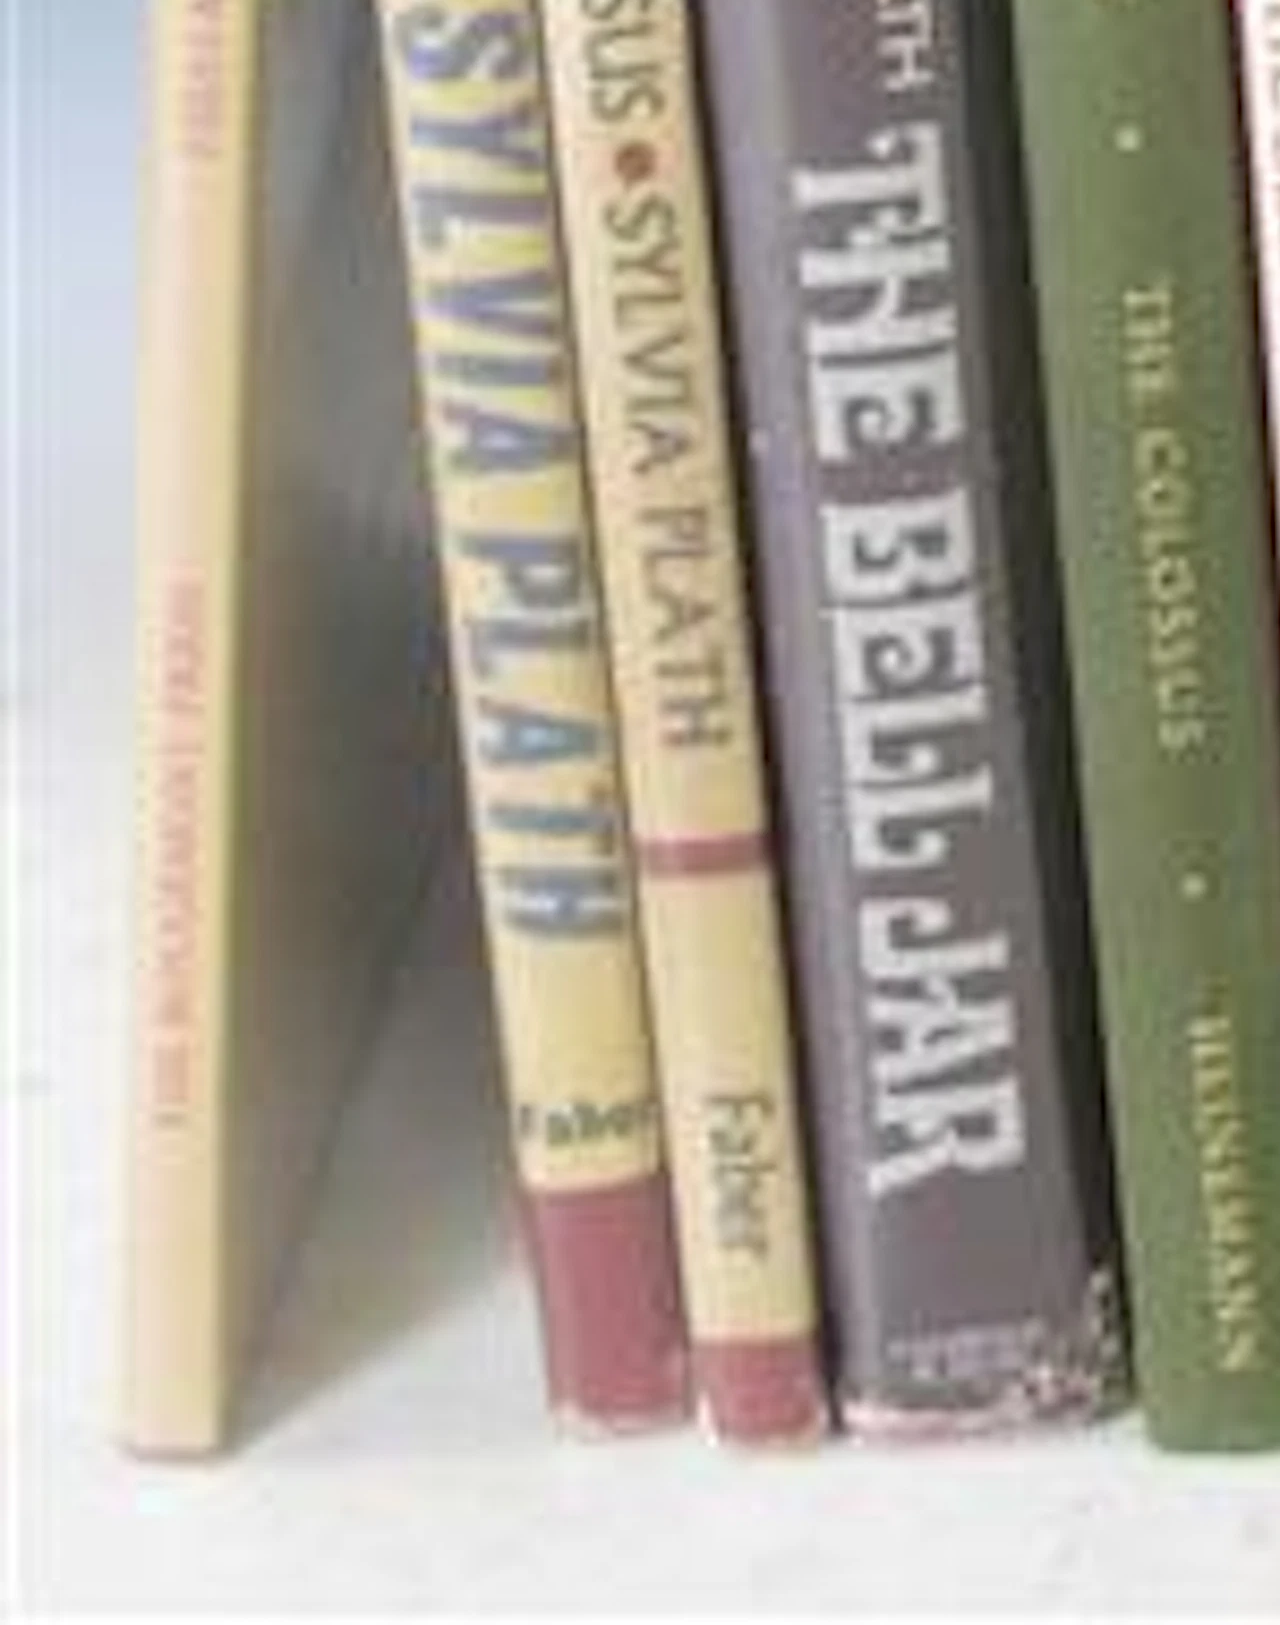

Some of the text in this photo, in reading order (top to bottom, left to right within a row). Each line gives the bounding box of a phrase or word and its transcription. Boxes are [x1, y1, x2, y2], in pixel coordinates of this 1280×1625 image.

[400, 4, 592, 482] SYLVIA
[603, 192, 698, 479] SYLVIA
[793, 124, 972, 461] THE
[640, 502, 738, 752] PLATH
[818, 487, 1000, 874] BELL
[1121, 277, 1208, 759] THE COLOSSUS
[455, 524, 640, 944] PLATH
[703, 1089, 782, 1262] Faber
[856, 892, 1032, 1204] JAR
